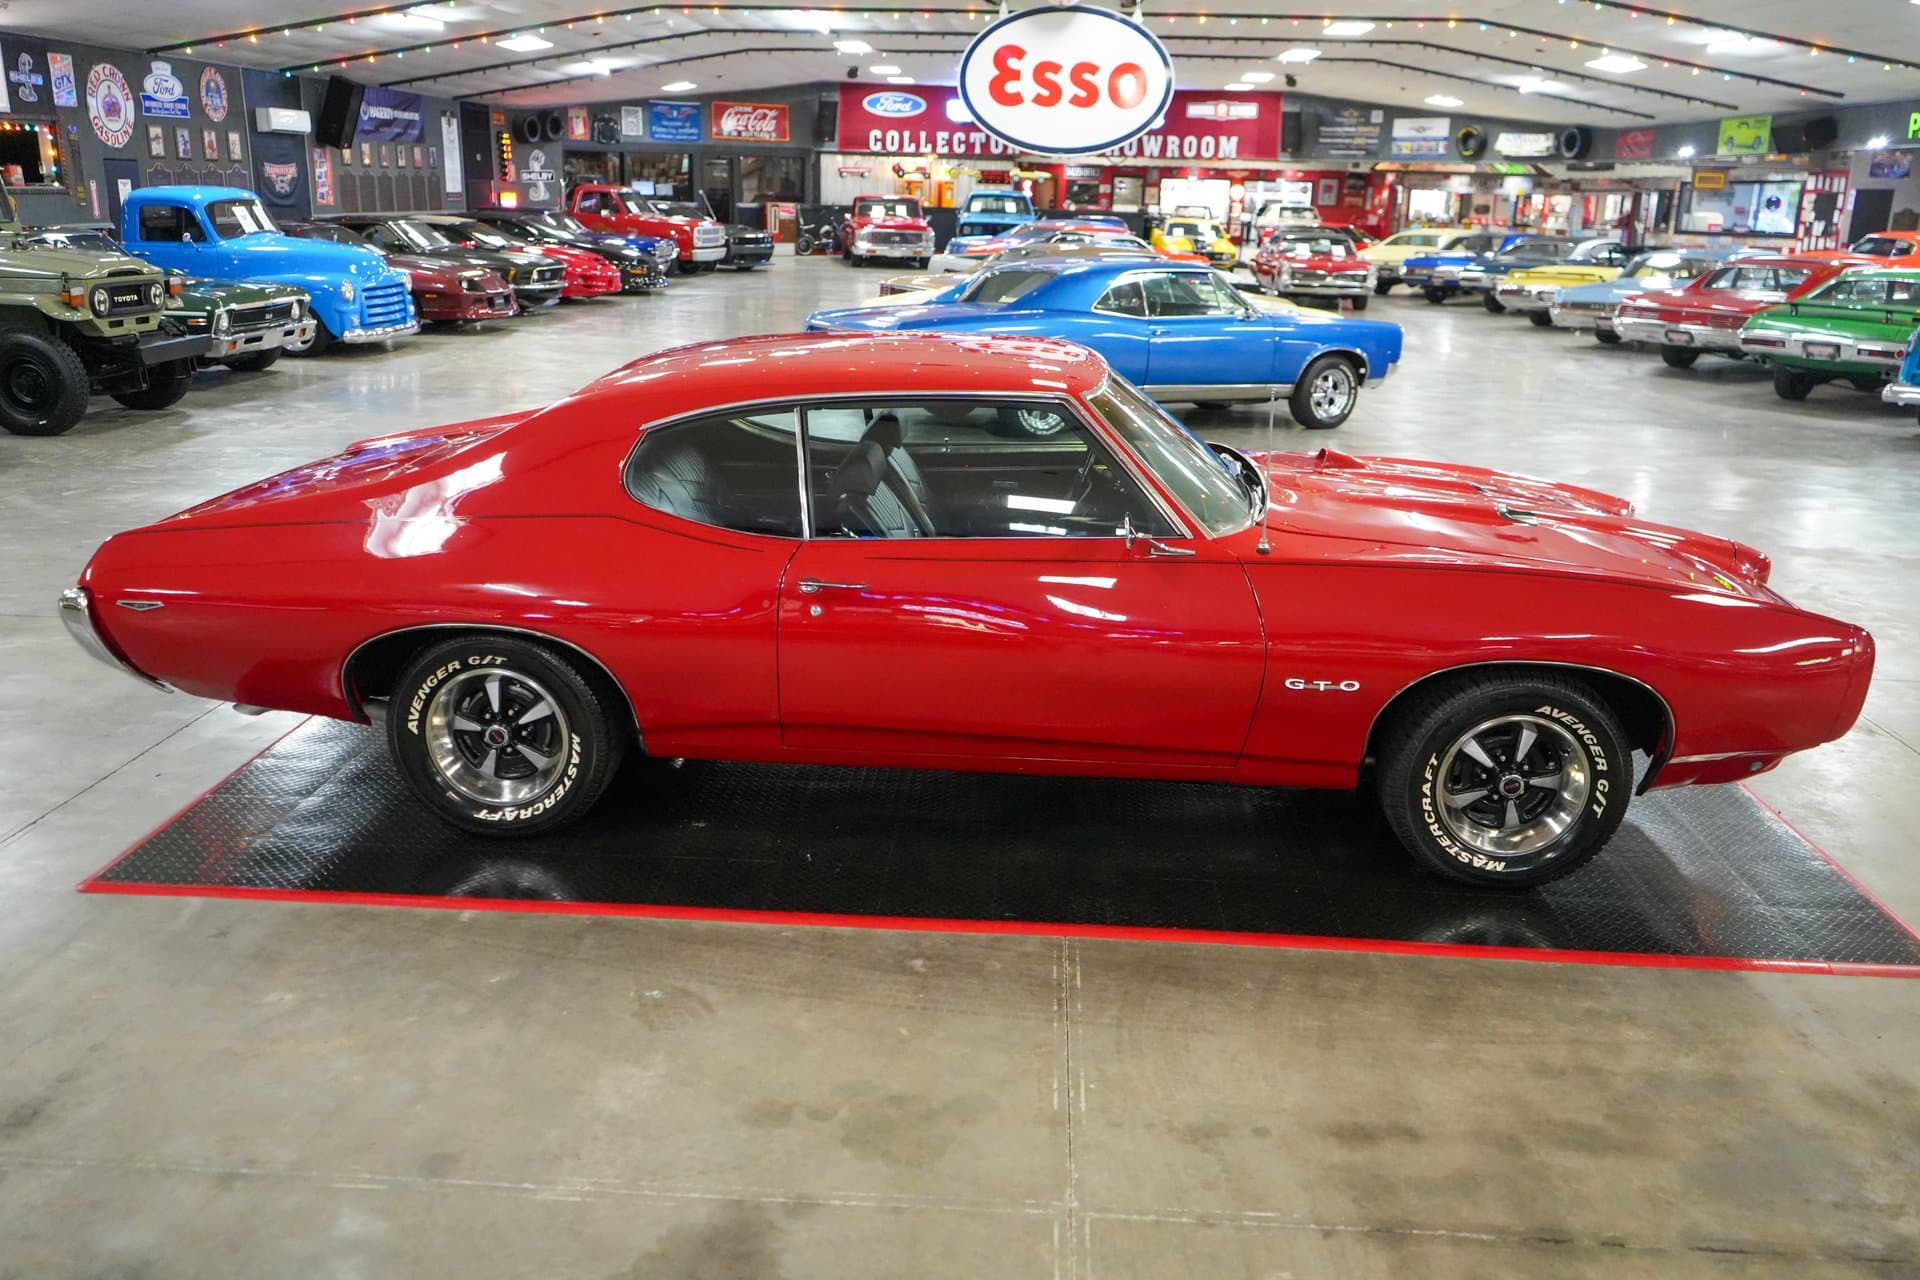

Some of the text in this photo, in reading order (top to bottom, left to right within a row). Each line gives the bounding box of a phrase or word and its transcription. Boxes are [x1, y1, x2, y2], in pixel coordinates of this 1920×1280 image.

[54, 73, 72, 90] GTX
[88, 65, 131, 102] RED CROWN
[152, 77, 175, 96] Ford
[876, 95, 912, 111] Ford
[93, 115, 134, 146] GASOLINE
[1104, 134, 1239, 159] OWROOM
[113, 294, 138, 303] TOYOTA
[408, 655, 508, 735] AVENGER G/T
[1285, 678, 1360, 691] GTO
[1535, 705, 1609, 819] AVENGER G/T
[474, 732, 581, 821] MASTERCRAFT
[1421, 753, 1506, 872] MASTERCRAFT
